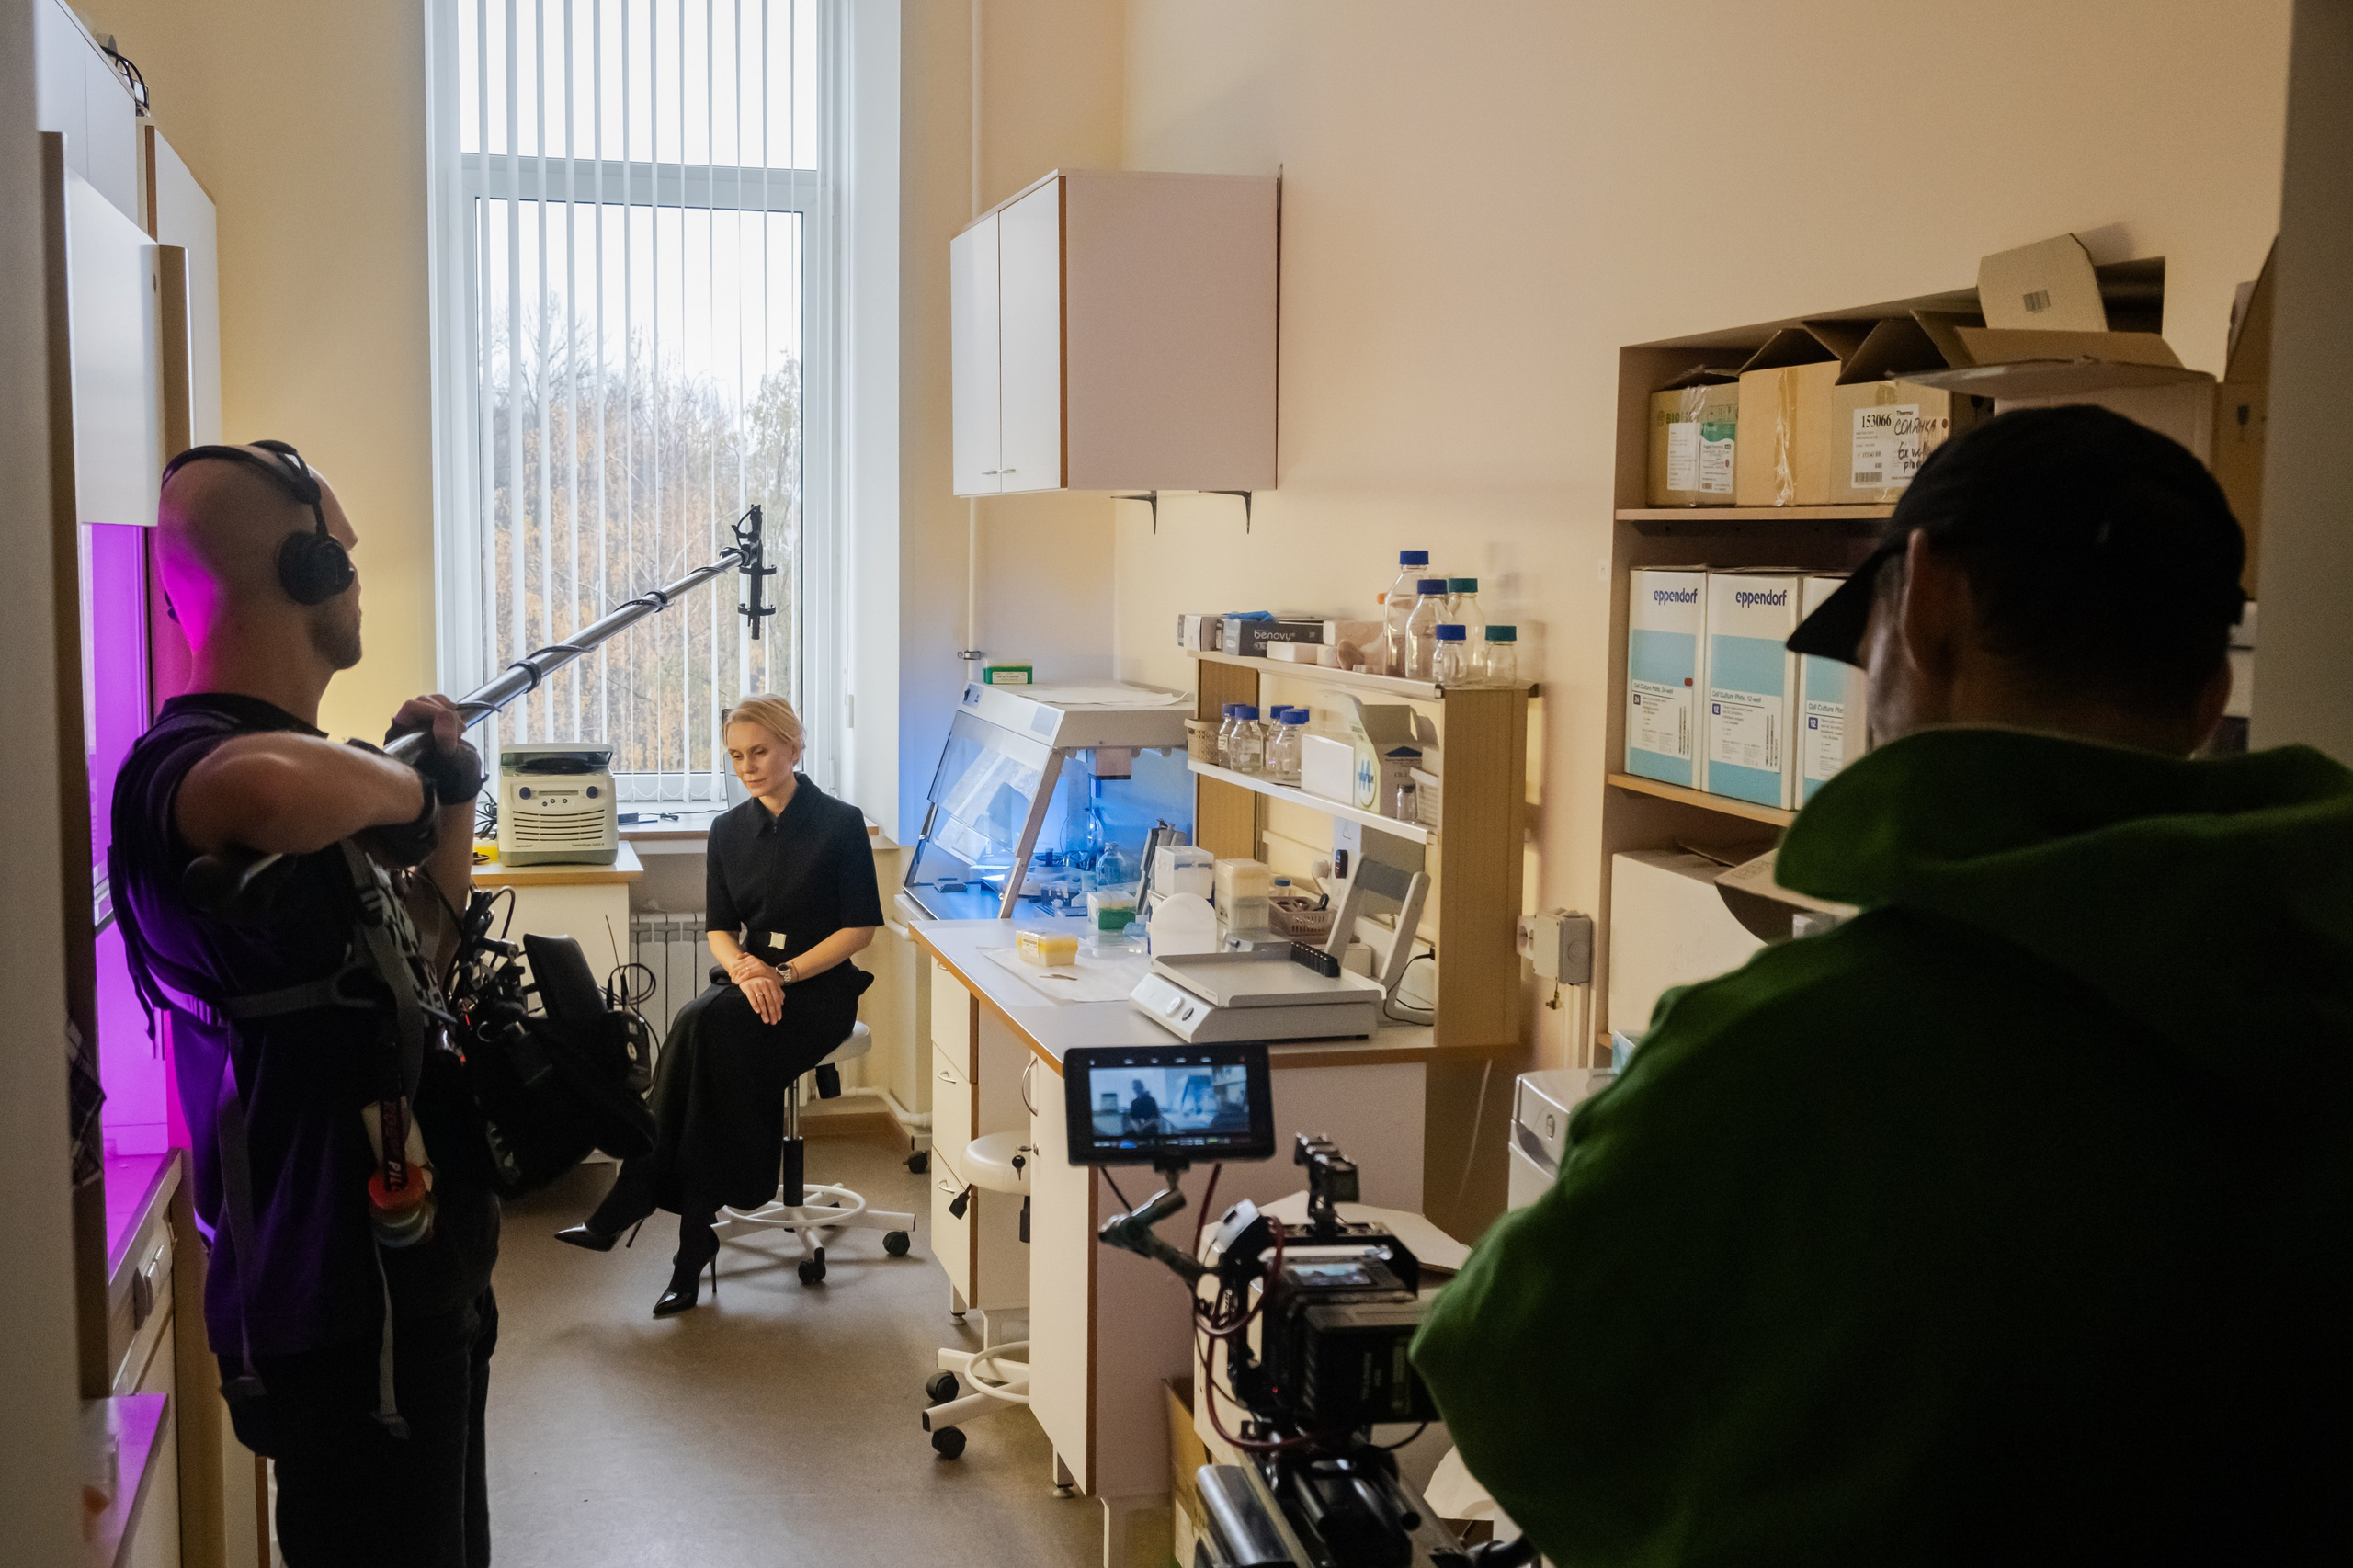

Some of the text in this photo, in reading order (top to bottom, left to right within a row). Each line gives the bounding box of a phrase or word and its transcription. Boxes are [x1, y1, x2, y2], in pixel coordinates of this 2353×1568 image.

[1862, 414, 1892, 428] 153066
[1894, 417, 1937, 436] СОЛЯНКА
[1654, 587, 1698, 606] eppendorf
[1735, 589, 1788, 608] eppendorf
[1254, 629, 1291, 642] benovy
[1720, 691, 1733, 699] Culture
[1747, 695, 1762, 703] 12-well
[1817, 704, 1834, 712] Culture
[1810, 719, 1816, 728] 12
